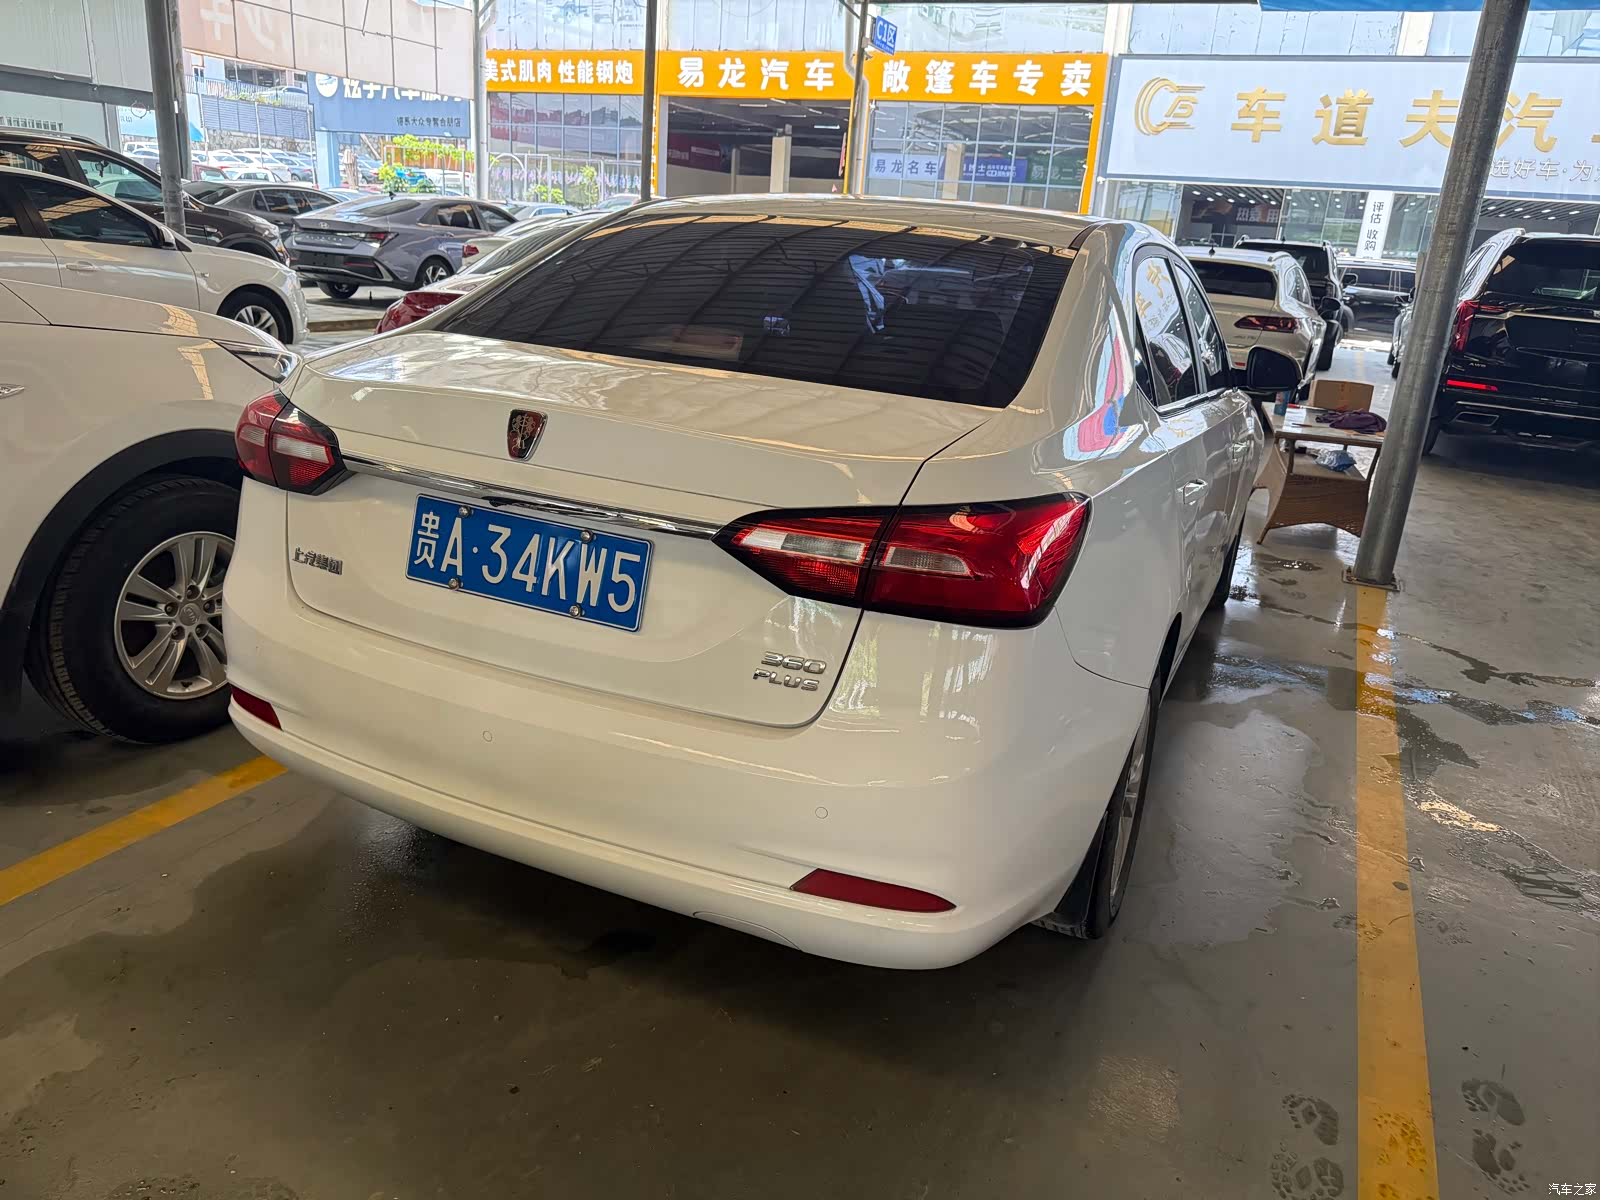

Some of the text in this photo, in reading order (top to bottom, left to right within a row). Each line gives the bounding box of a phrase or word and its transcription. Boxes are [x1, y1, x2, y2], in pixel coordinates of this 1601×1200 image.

[876, 20, 896, 48] C1区
[485, 58, 634, 85] 美式肌肉 性能钢炮
[677, 57, 835, 91] 易龙汽车
[881, 59, 1092, 97] 敞篷车专卖
[1231, 86, 1600, 153] 车道夫汽
[874, 159, 938, 176] 易龙名车
[1491, 157, 1600, 182] 选好车·为
[1363, 201, 1385, 251] 评估 收购
[292, 546, 343, 576] 上汽集团
[414, 511, 641, 613] 贵A·34KW5
[761, 650, 827, 675] 360
[753, 667, 820, 692] PLUS
